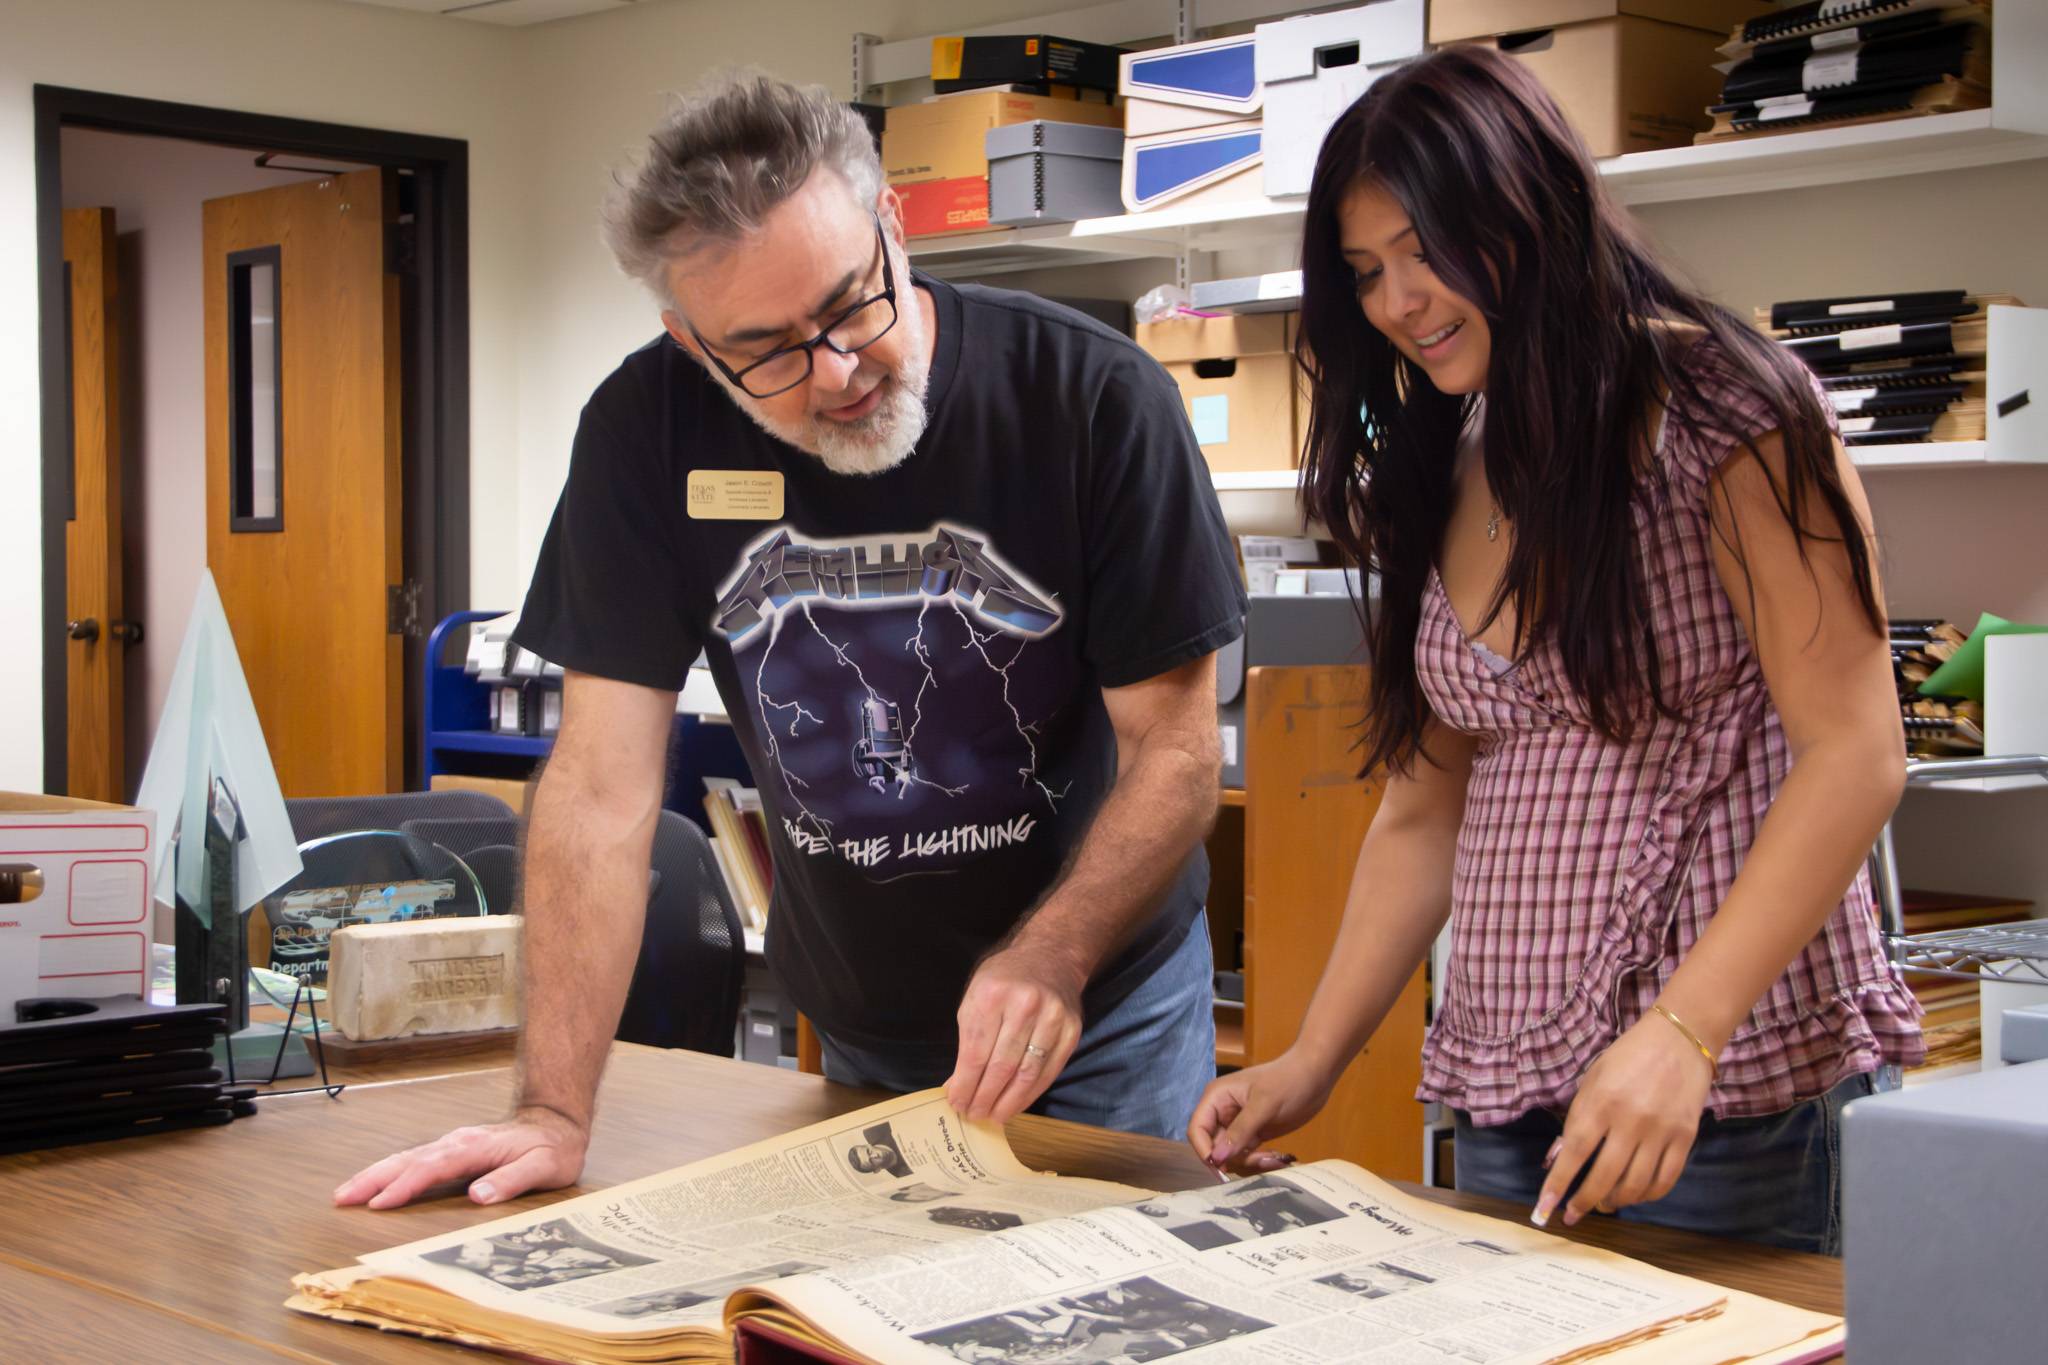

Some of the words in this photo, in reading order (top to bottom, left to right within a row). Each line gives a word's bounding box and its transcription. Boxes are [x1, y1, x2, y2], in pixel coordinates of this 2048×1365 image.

[837, 835, 892, 867] THE
[898, 813, 1037, 860] LIGHTNING
[271, 959, 330, 980] Departm
[854, 1293, 907, 1332] Wrecks
